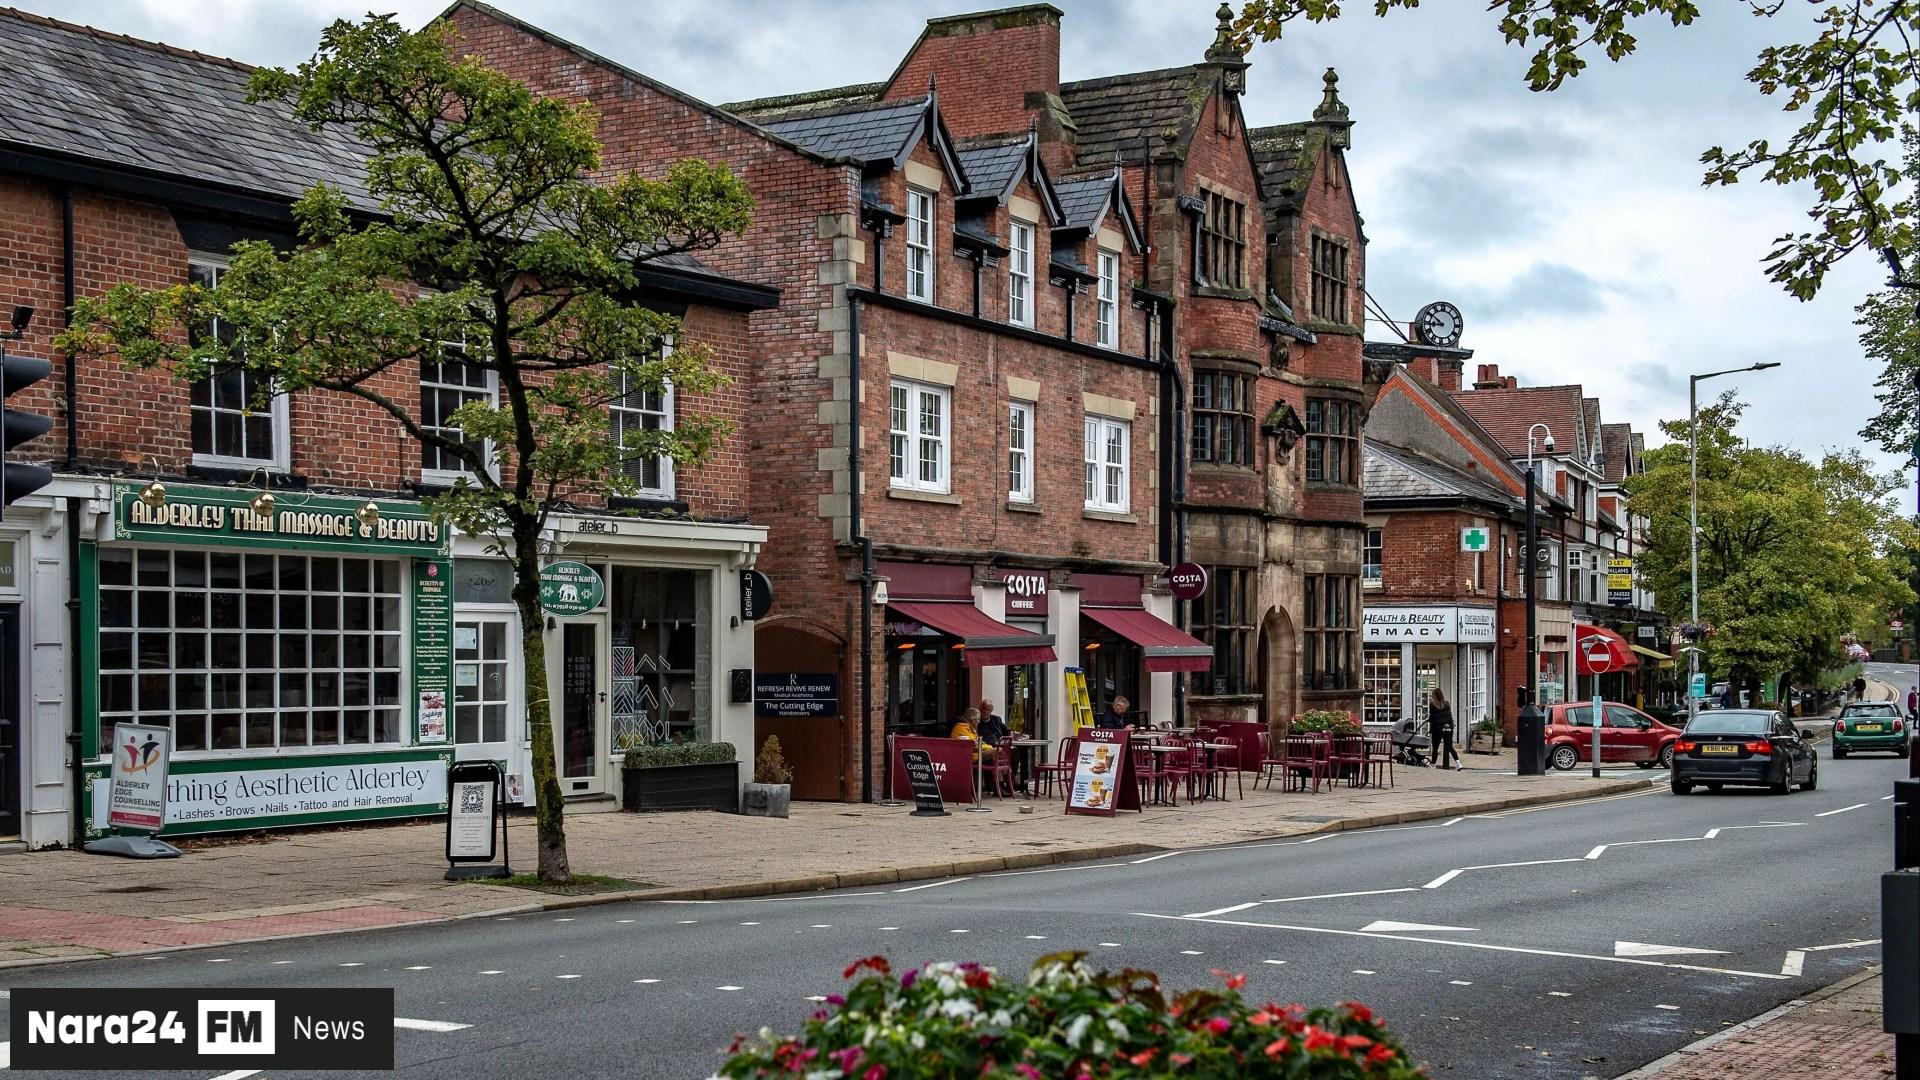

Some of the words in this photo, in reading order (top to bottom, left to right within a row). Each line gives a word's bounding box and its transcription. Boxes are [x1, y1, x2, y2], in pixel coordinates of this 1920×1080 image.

[131, 500, 225, 529] ALDERLEY
[231, 506, 274, 532] THAI
[279, 510, 354, 537] MASSAGE
[376, 516, 439, 542] BEAUTY
[1172, 574, 1202, 584] COSTA
[1007, 574, 1046, 597] COSTA
[744, 573, 753, 618] atelier_b
[1011, 600, 1034, 609] COFFEE
[1363, 614, 1398, 624] HEALTH
[1408, 614, 1446, 624] BEAUTY
[1370, 628, 1445, 636] RMACY
[780, 702, 805, 711] Cutting
[806, 702, 824, 711] Edge
[1091, 730, 1114, 738] COSTA
[906, 763, 931, 772] Cutting
[912, 772, 929, 780] Edge
[115, 780, 150, 790] ALDERLEY
[166, 779, 228, 806] thing
[235, 771, 339, 798] Aesthetic
[345, 767, 430, 791] Alderley
[114, 788, 132, 797] EDGE
[114, 795, 160, 807] COUNSELLING
[178, 808, 215, 820] Lashes
[225, 805, 255, 817] Brows
[265, 802, 289, 813] Nails
[299, 800, 328, 811] Tattoo
[332, 797, 349, 808] and
[354, 796, 372, 807] Hair
[375, 793, 413, 805] Removal
